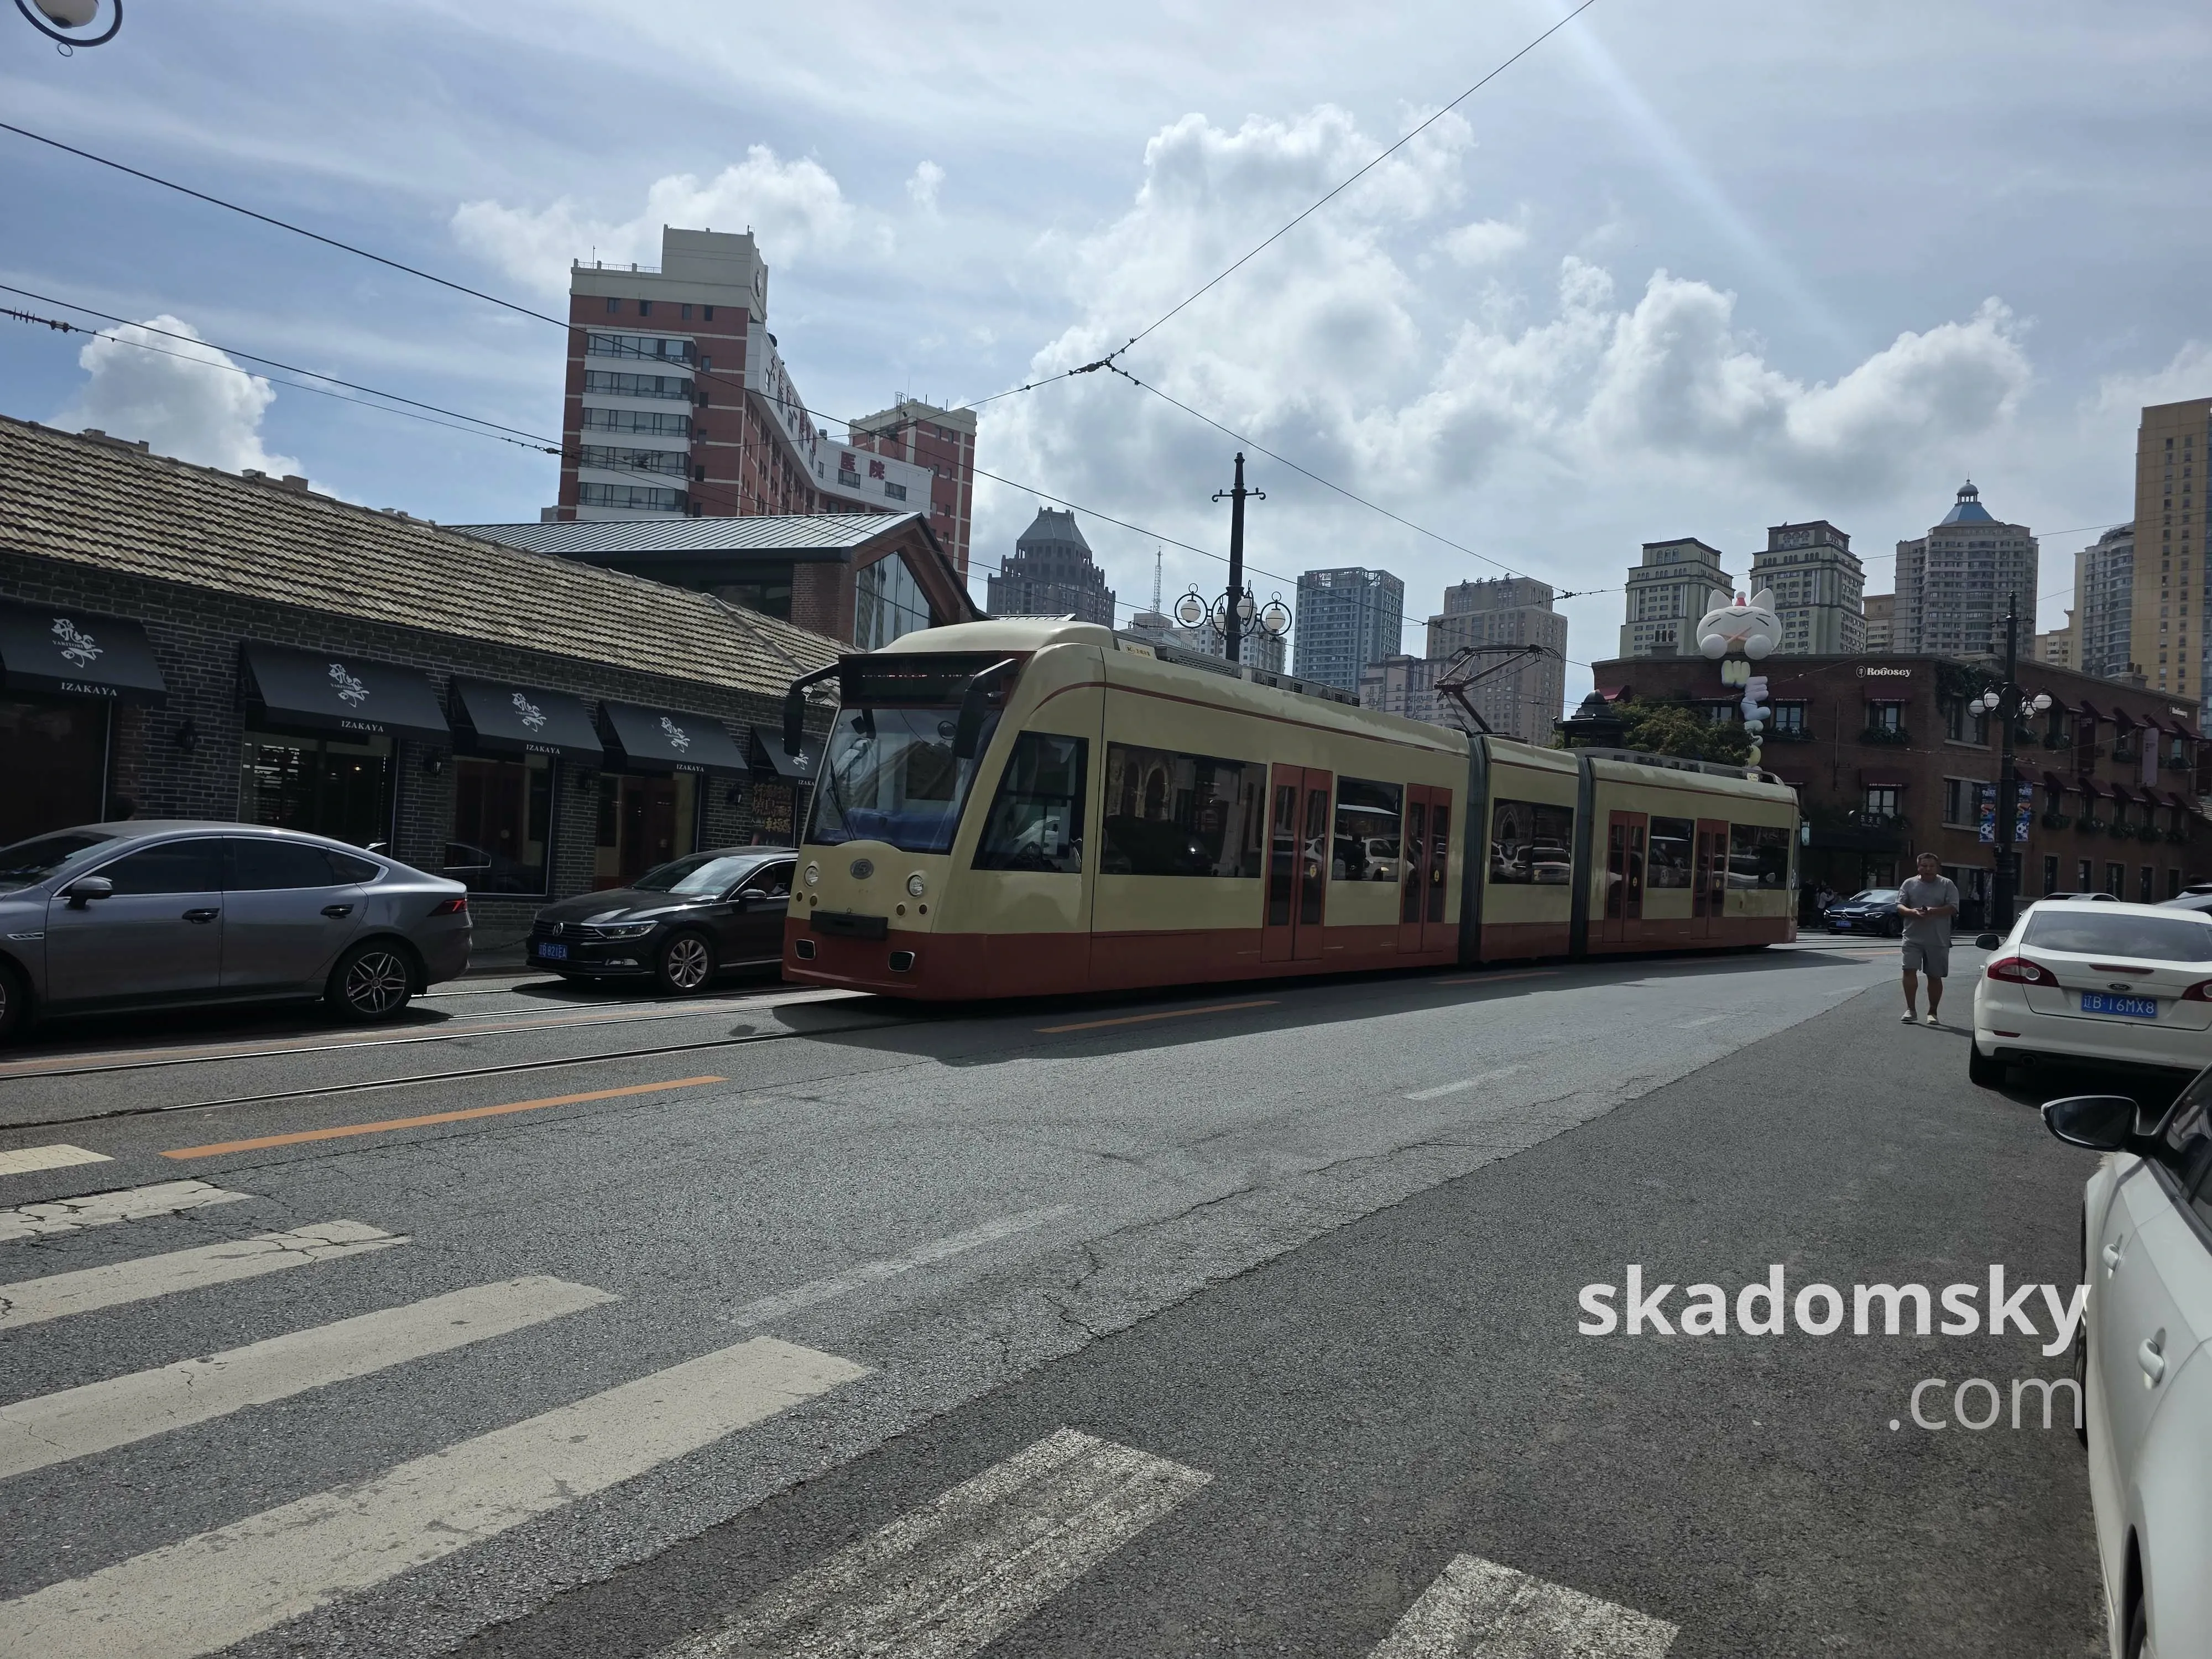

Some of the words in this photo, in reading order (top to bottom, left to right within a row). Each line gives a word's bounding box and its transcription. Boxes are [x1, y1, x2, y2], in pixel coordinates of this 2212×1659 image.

[841, 451, 885, 481] 医院
[61, 682, 117, 696] IZAKAYA
[341, 721, 384, 732] IZAKAYA
[526, 744, 560, 754] IZAKAYA
[677, 764, 704, 772] IZAKAYA
